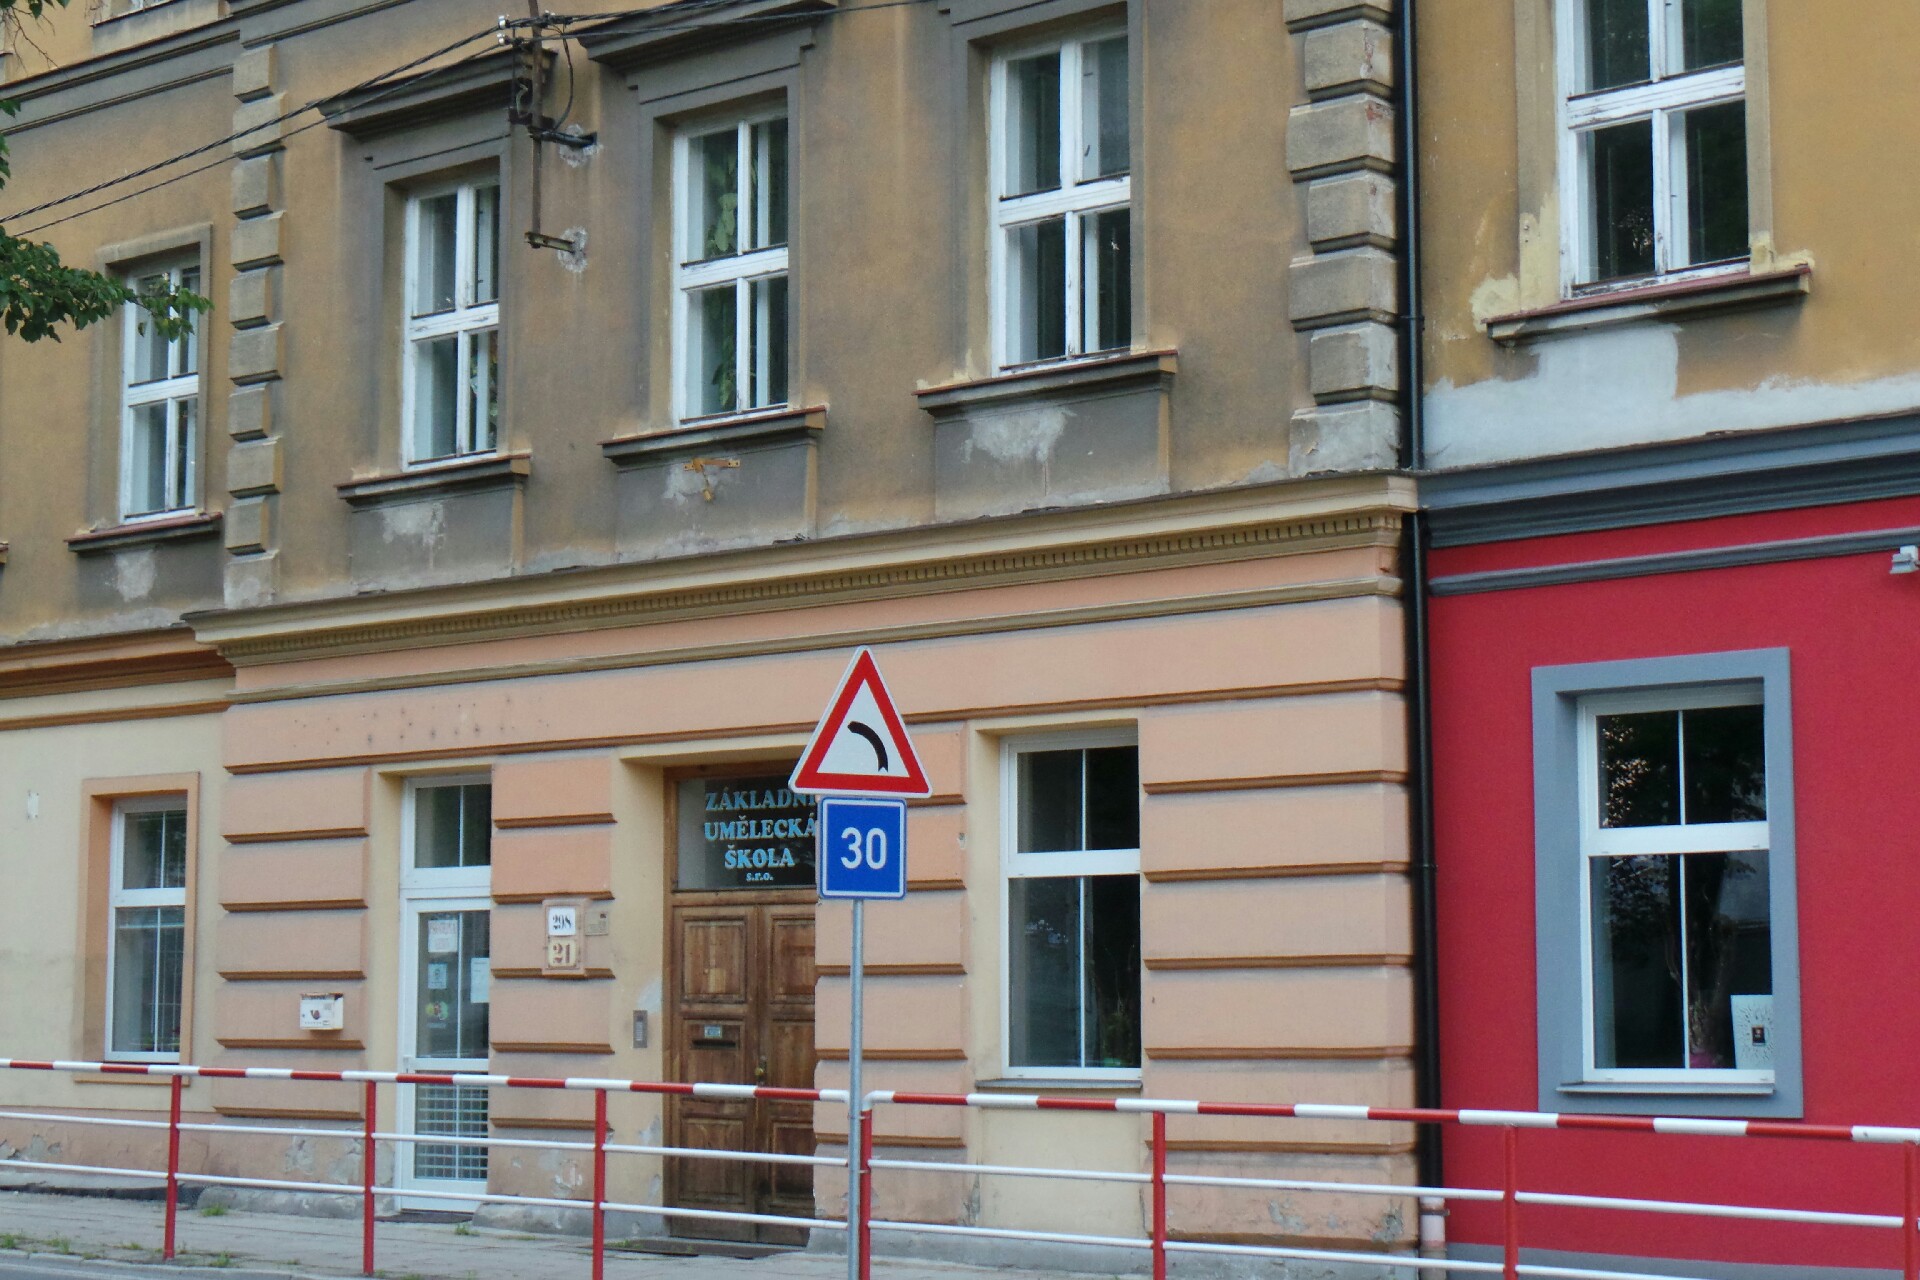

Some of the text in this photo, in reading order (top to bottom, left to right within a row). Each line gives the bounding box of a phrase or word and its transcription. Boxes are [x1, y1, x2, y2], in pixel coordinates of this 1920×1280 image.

[704, 812, 816, 840] UMĚLECKÁ
[724, 844, 795, 869] ŠKOLA
[841, 827, 887, 869] 30
[745, 872, 774, 882] s.r.o.
[552, 914, 572, 930] 298
[552, 943, 571, 963] 21
